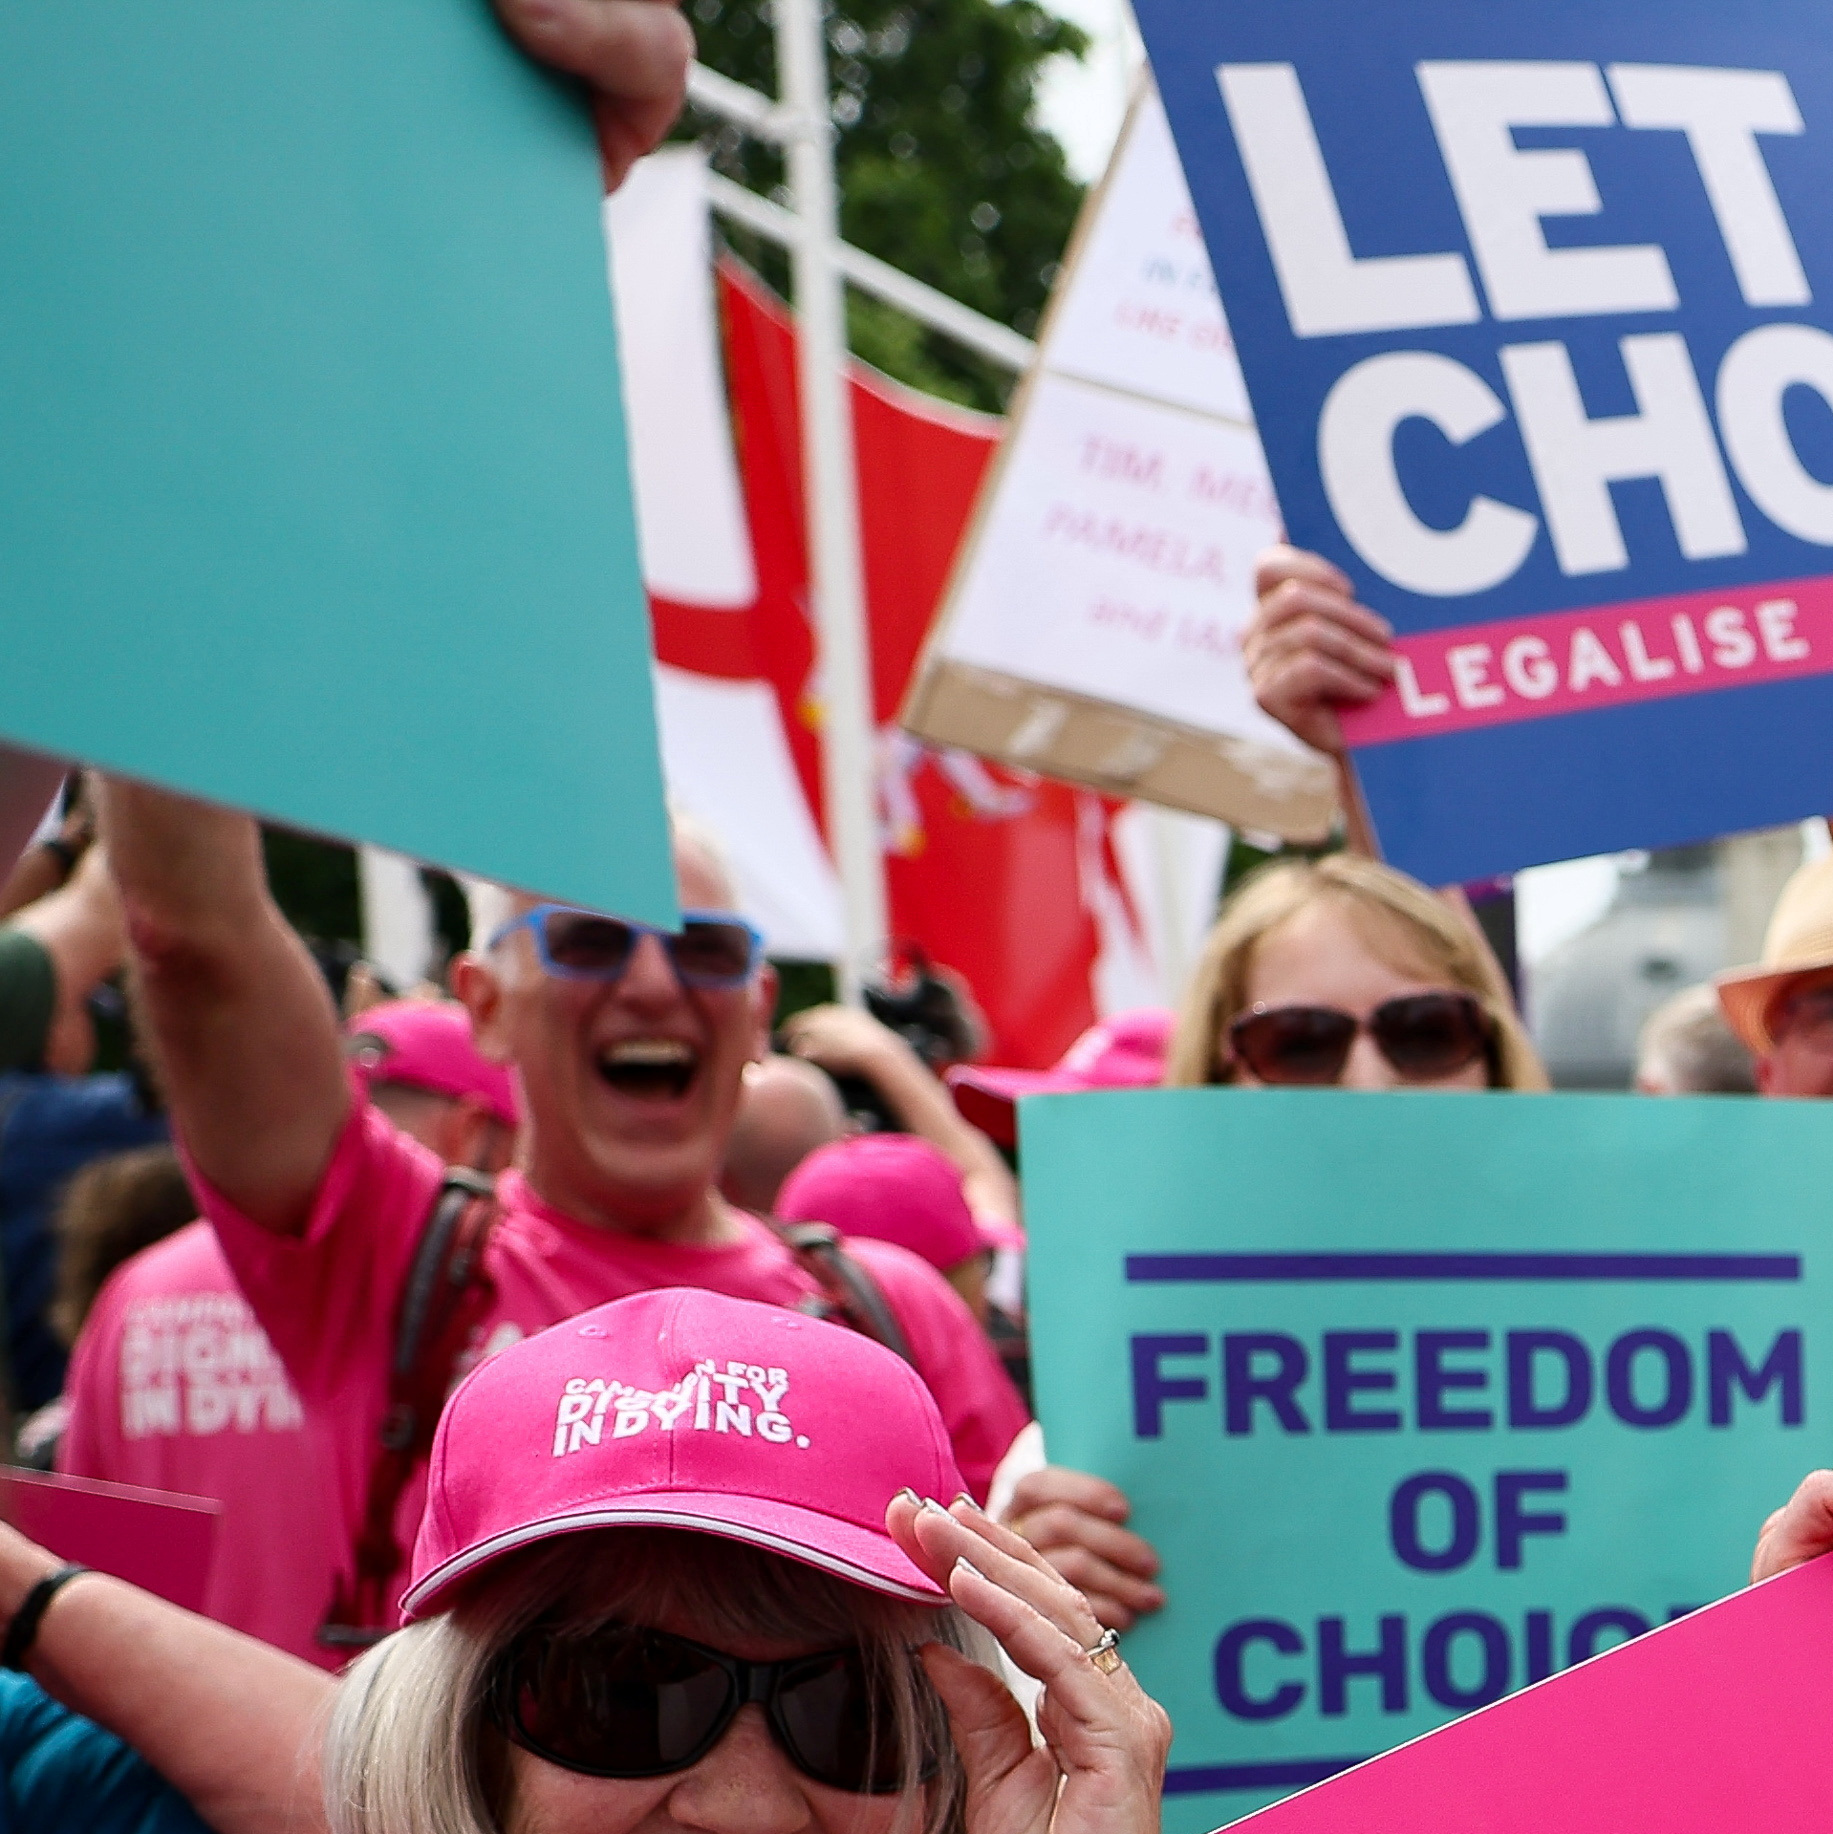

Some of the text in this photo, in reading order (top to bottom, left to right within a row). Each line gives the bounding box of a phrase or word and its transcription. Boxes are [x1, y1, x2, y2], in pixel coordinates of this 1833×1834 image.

[1216, 60, 1808, 338] LET
[1398, 600, 1811, 720] LEGALISE
[552, 1412, 606, 1459] IN
[1130, 1326, 1806, 1440] FREEDOM
[1388, 1470, 1570, 1573] OF
